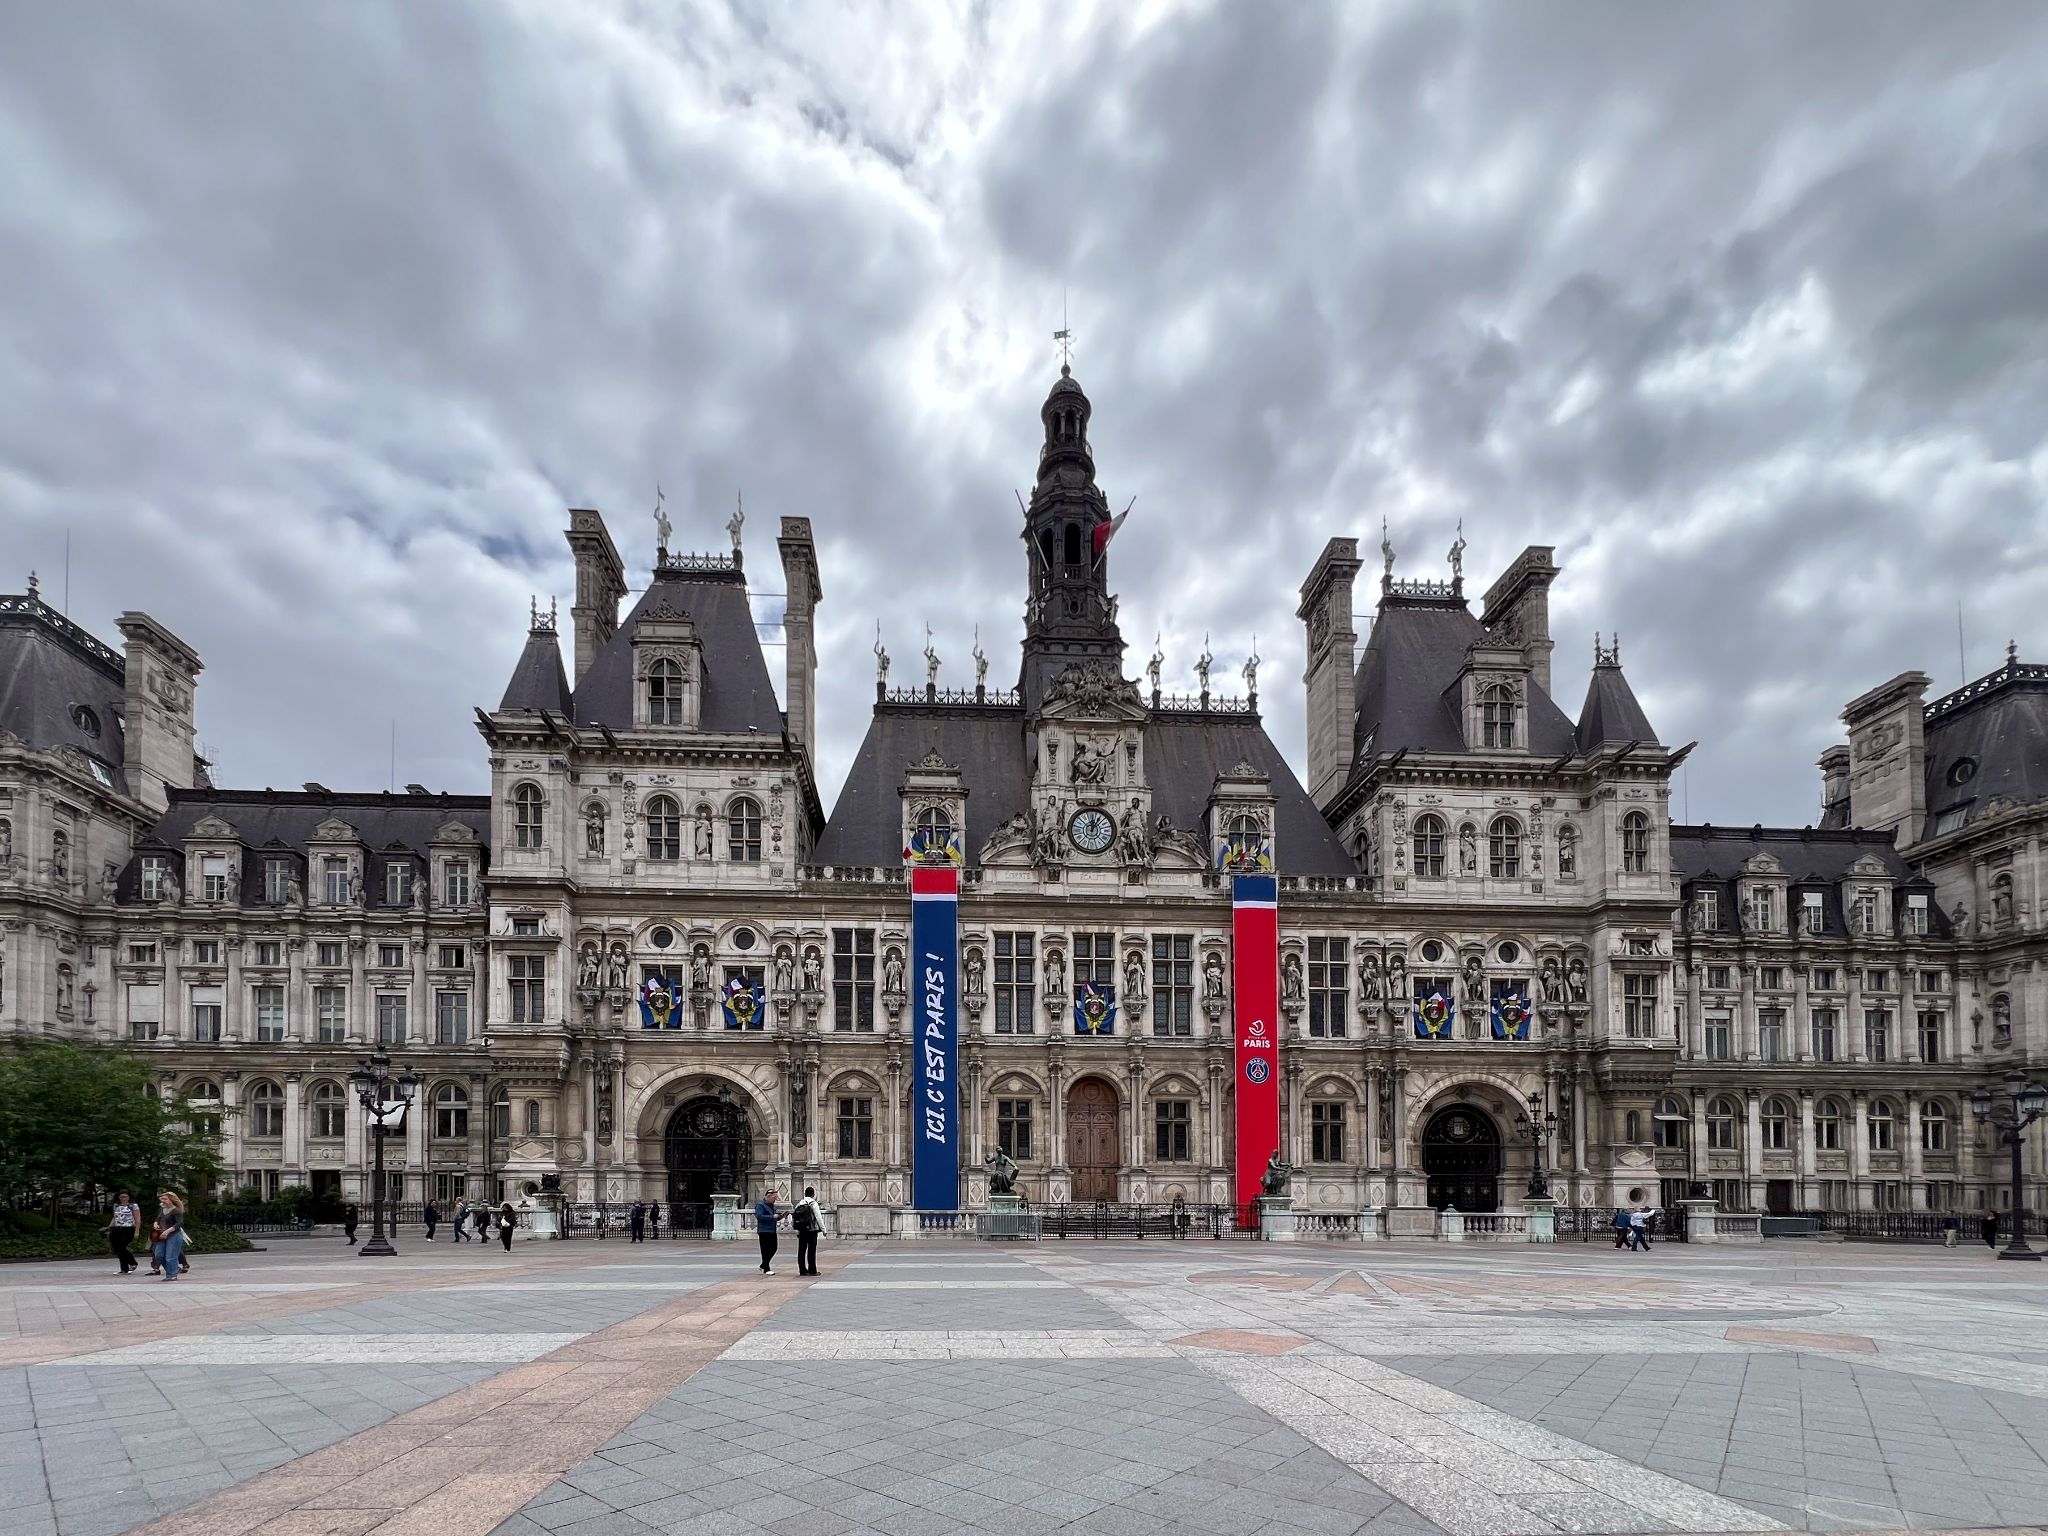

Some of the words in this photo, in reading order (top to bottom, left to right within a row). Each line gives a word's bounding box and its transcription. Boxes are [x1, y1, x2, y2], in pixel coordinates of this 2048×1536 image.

[925, 966, 946, 1040] PARIS
[1244, 1040, 1271, 1048] PARIS
[924, 1039, 946, 1103] C'EST
[925, 1106, 946, 1144] ICI,
